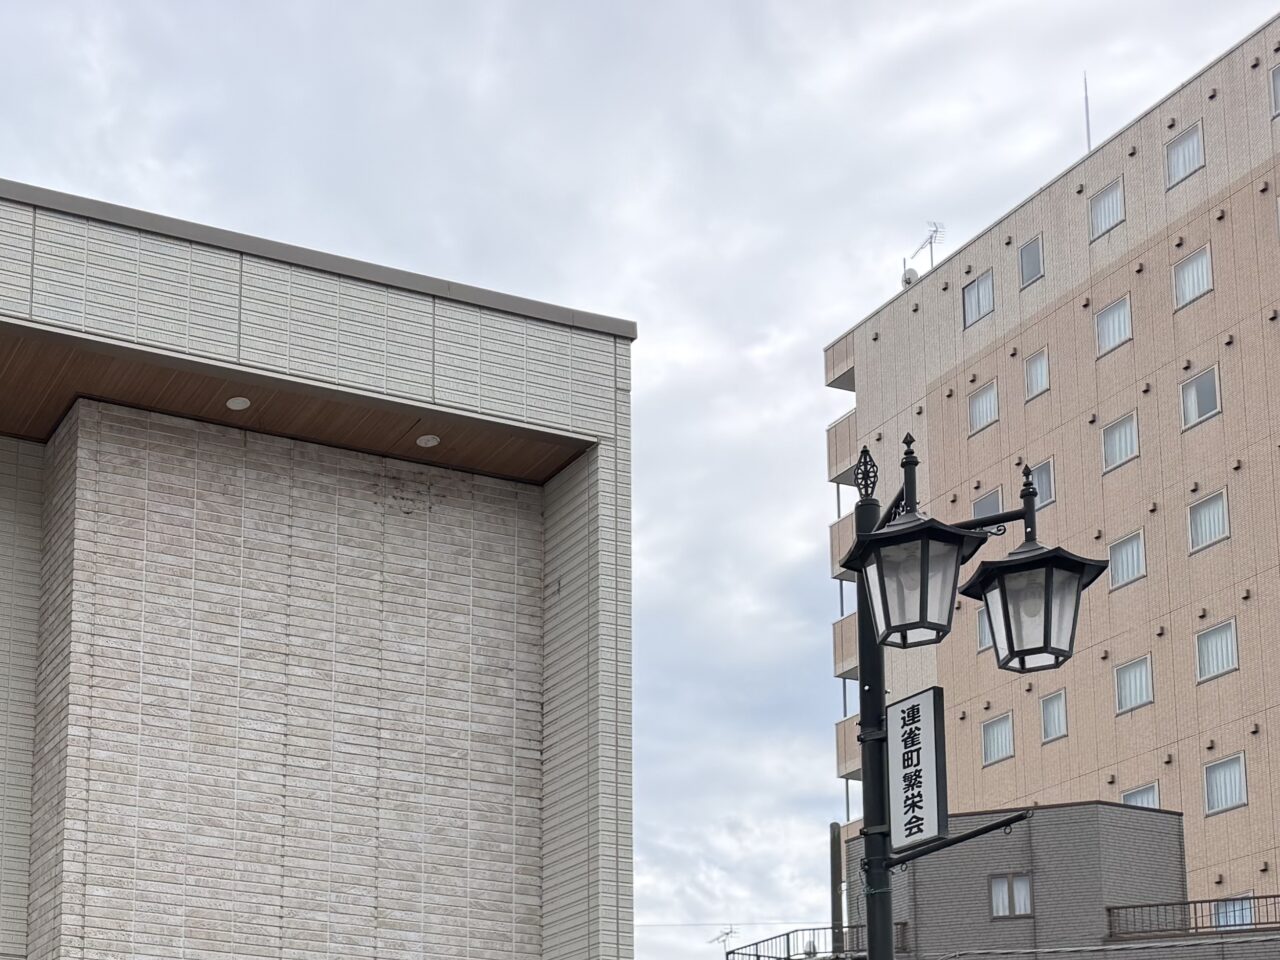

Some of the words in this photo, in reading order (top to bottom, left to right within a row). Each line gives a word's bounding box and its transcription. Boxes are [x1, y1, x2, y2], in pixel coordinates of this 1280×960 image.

[900, 703, 925, 839] 連雀町繁栄会
